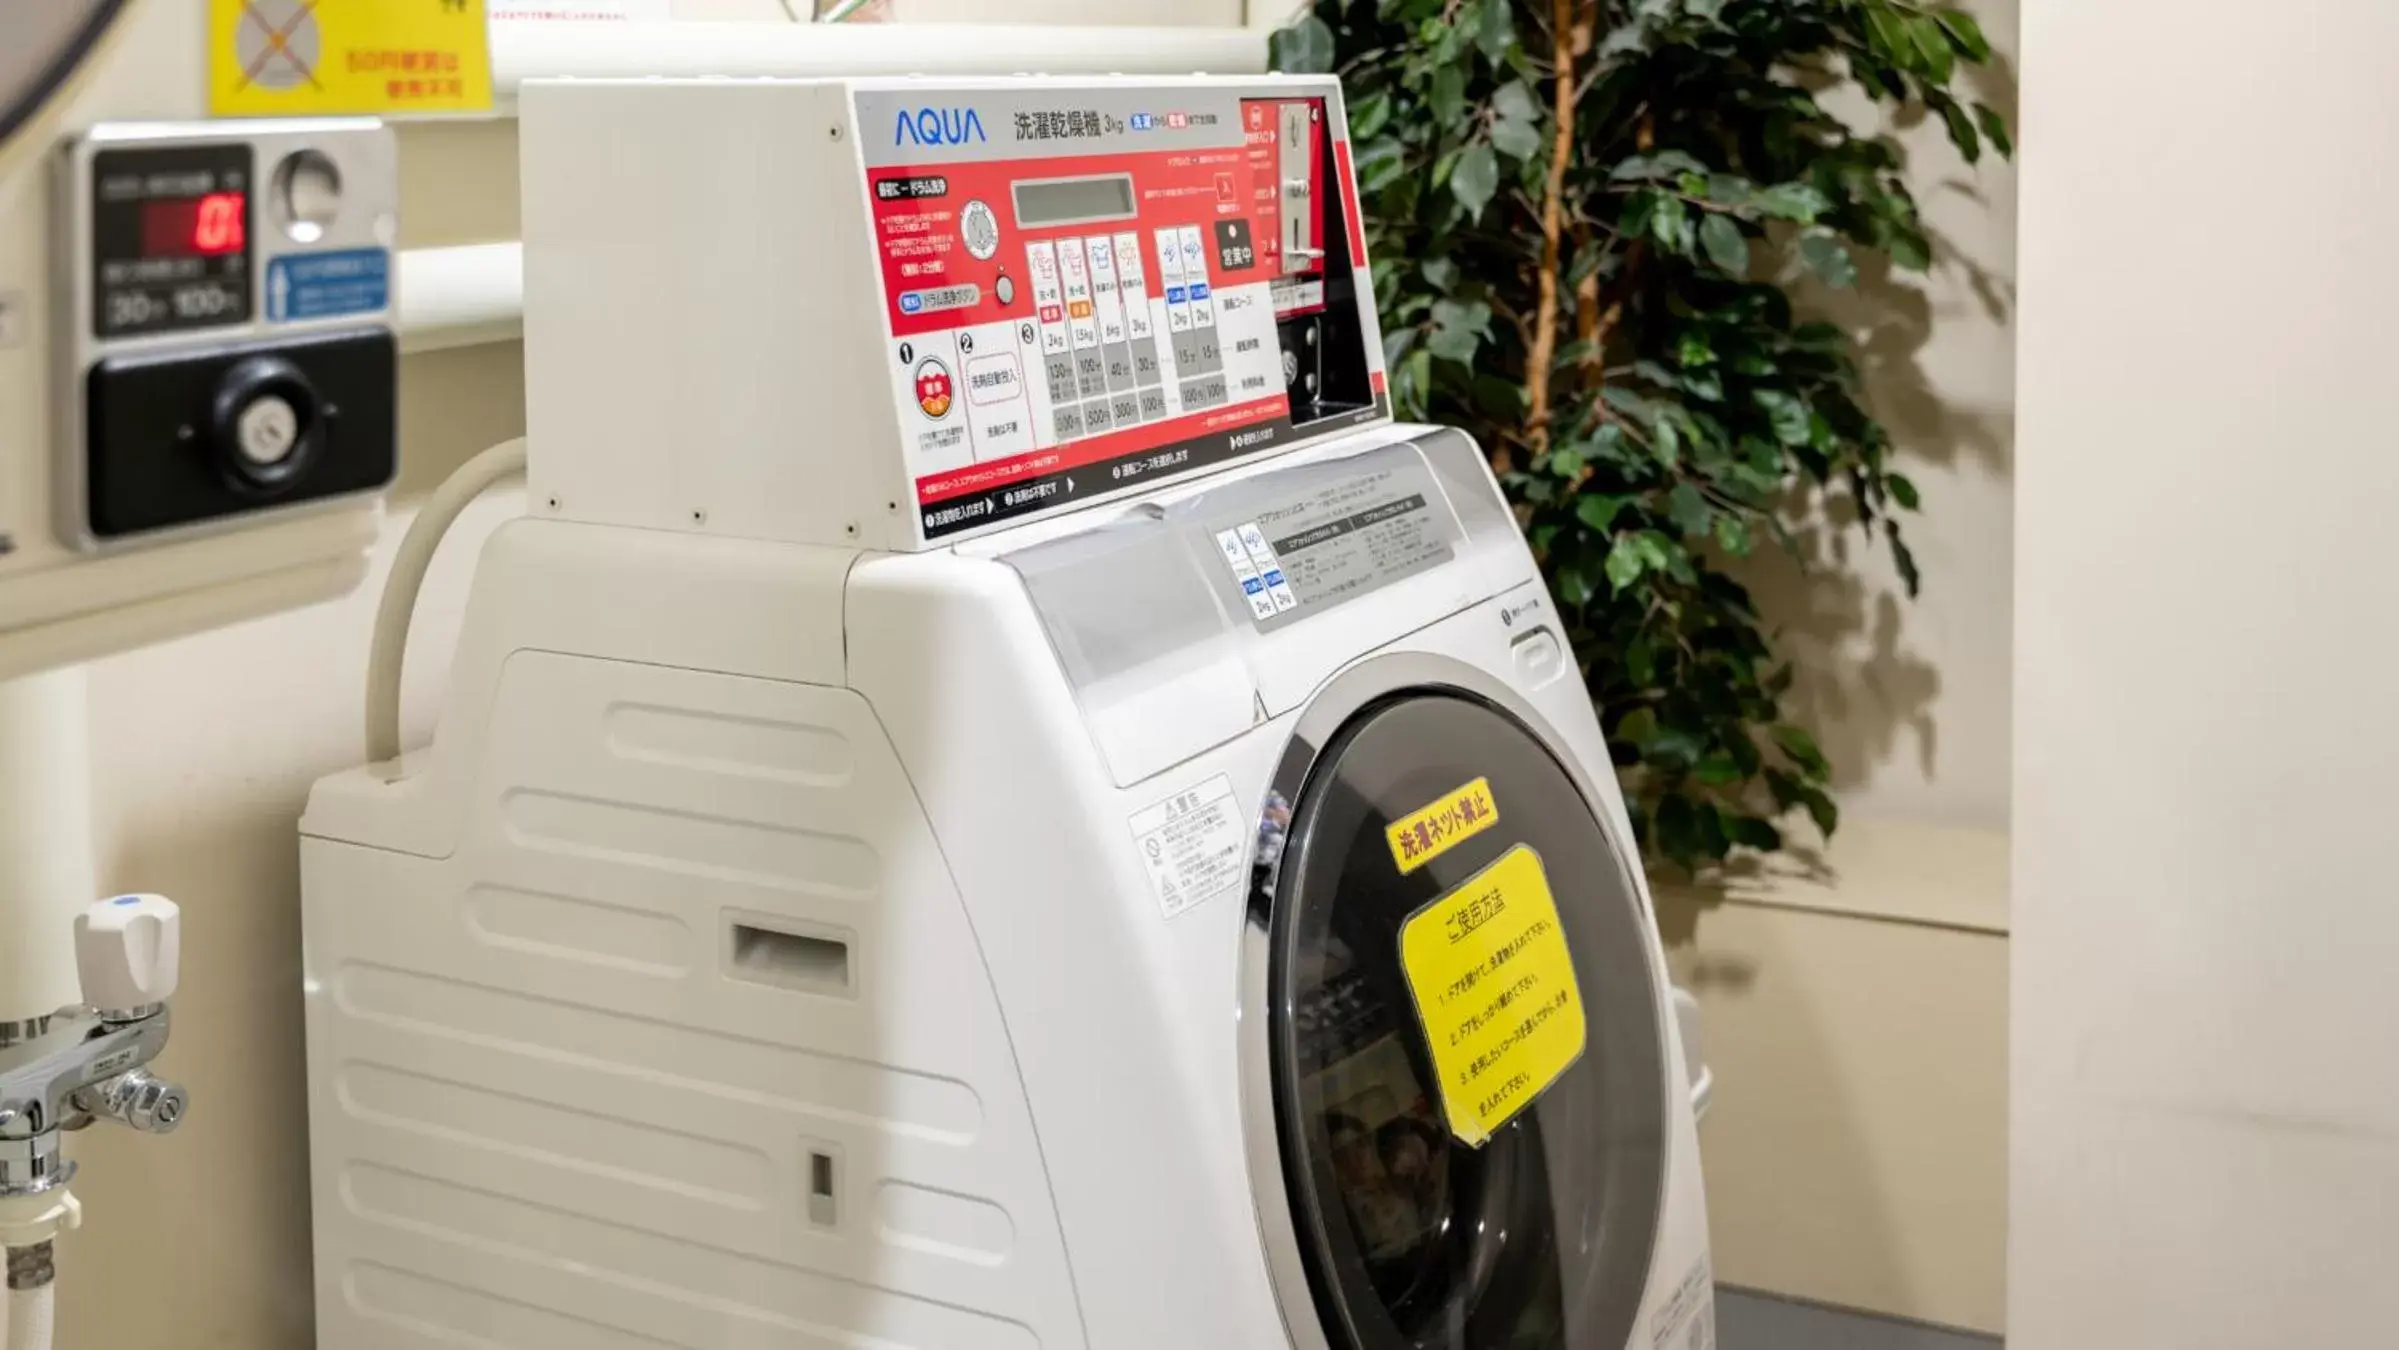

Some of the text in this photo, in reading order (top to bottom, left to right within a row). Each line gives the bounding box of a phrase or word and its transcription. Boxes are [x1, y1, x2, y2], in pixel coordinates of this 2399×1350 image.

[895, 107, 986, 146] AQUA
[1013, 110, 1102, 140] 洗濯乾燥機
[1103, 113, 1124, 134] 3kg
[1222, 247, 1252, 267] 営業中
[1398, 790, 1490, 861] 洗濯ネット禁止
[1445, 887, 1506, 941] ご使用方法
